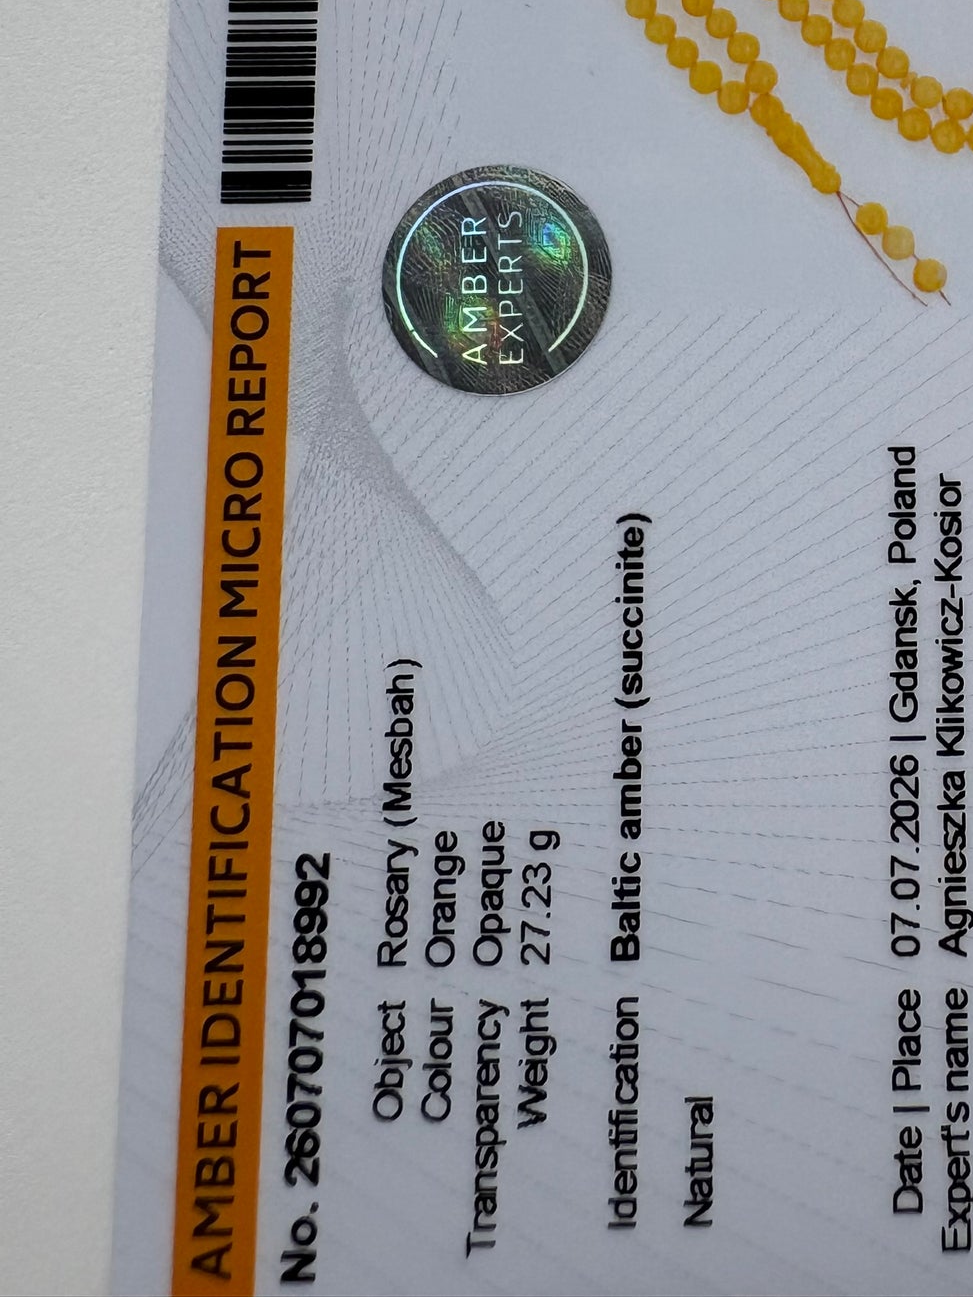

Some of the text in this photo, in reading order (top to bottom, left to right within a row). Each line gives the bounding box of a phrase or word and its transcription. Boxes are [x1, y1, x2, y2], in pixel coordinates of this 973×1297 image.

[458, 217, 488, 366] AMBER
[497, 211, 525, 365] EXPERTS
[887, 446, 917, 564] Poland
[888, 579, 922, 723] Gdansk,
[933, 472, 966, 757] Klikowicz-Kosior
[190, 240, 272, 1281] AMBER IDENTIFICATION MICRO REPORT
[889, 754, 921, 958] 07.07.2026
[372, 658, 423, 1123] Object Rosary (Mesbah)
[607, 512, 653, 1230] Identification Baltic amber (succinite)
[279, 852, 331, 1285] No. 260707018992
[420, 830, 466, 1124] Colour Orange
[465, 820, 513, 1259] Transparency Opaque
[516, 830, 561, 1130] Weight 27.23 g
[891, 988, 922, 1092] Place
[945, 987, 970, 1092] name
[683, 1096, 714, 1228] Natural
[892, 1125, 924, 1215] Date
